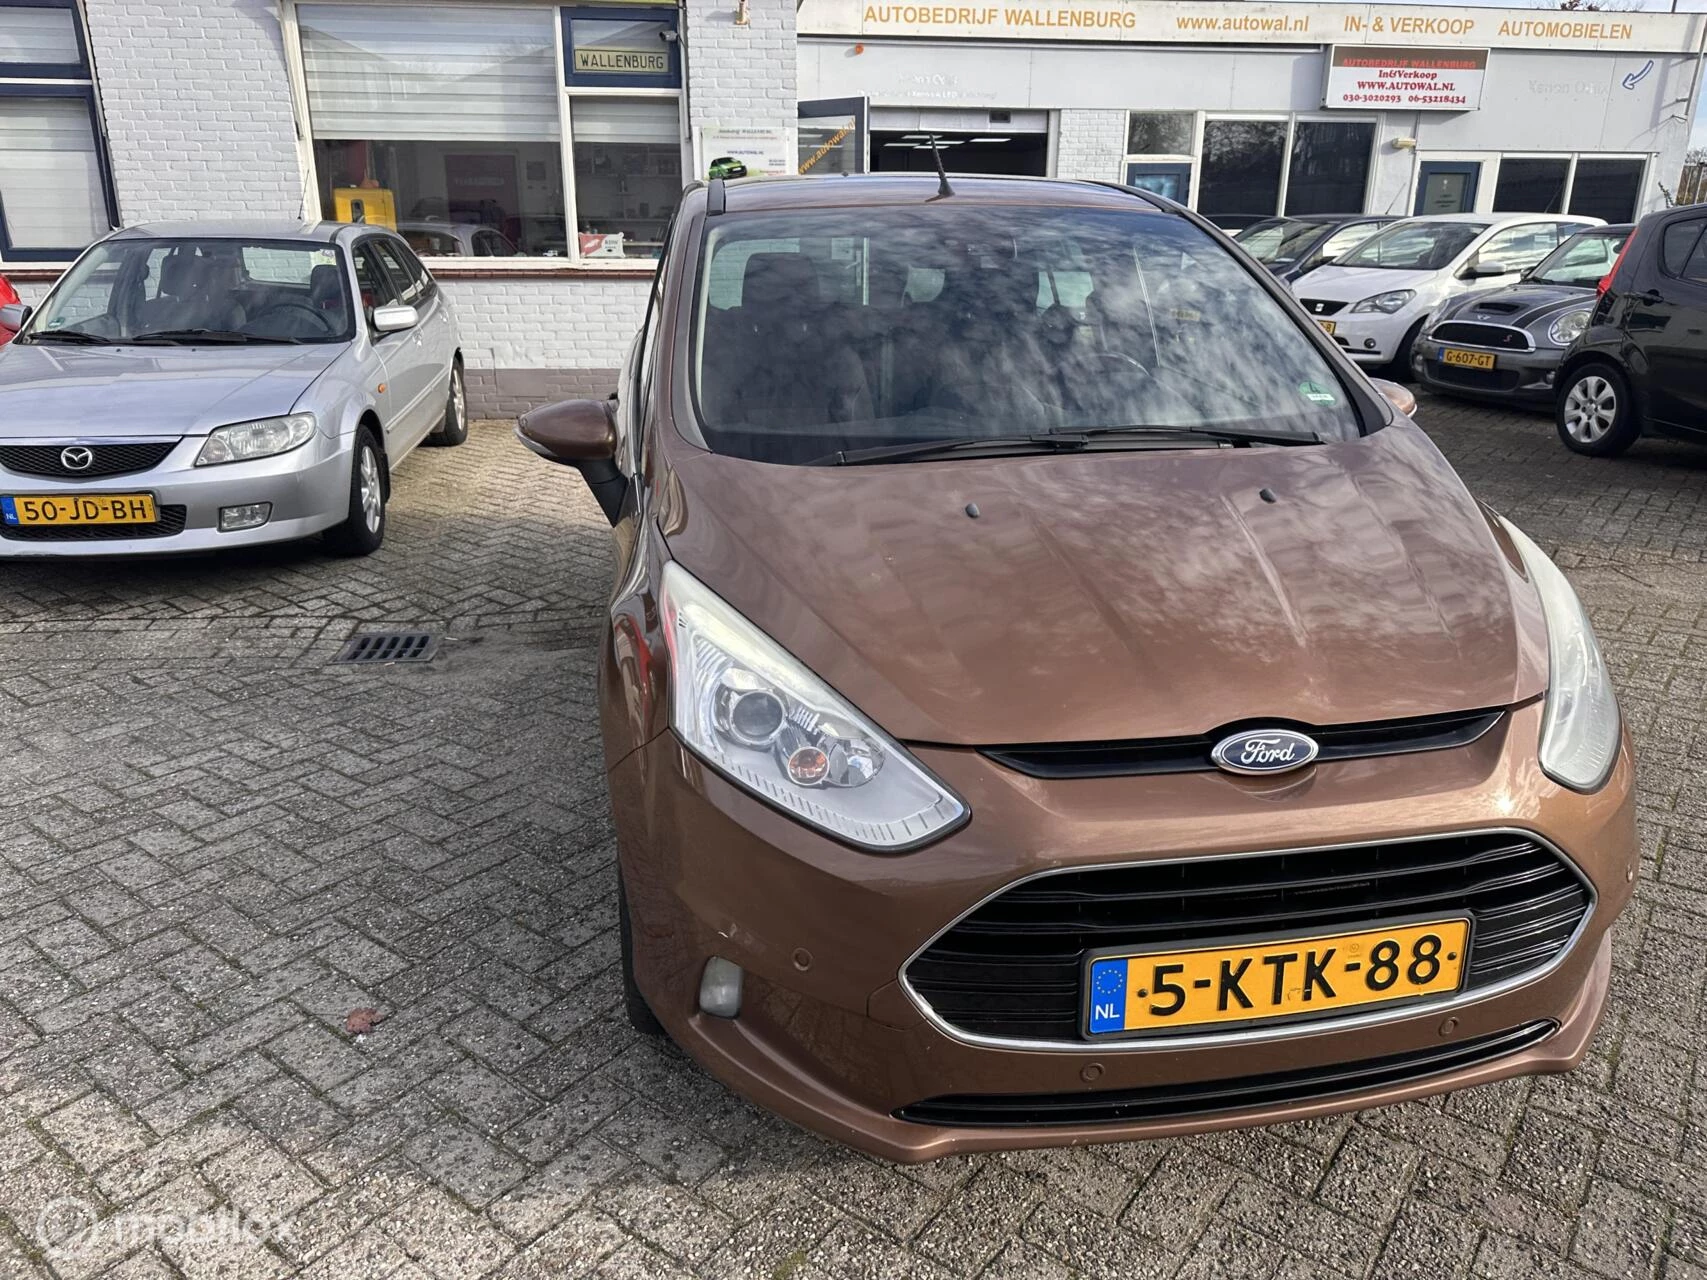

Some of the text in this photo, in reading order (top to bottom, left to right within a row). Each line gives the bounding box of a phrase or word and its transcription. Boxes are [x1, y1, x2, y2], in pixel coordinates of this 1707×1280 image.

[863, 7, 1136, 29] AUTOBEDRIJF WALLENBURG
[1176, 15, 1309, 32] www.autowal.nl
[1344, 15, 1475, 35] IN- & VERKOOP
[1498, 20, 1632, 40] AUTOMOBIELEN
[580, 54, 664, 69] WALLENBURG
[1357, 81, 1456, 91] WWW.AUTOWAL.NL
[1446, 350, 1492, 367] G-607-GT
[23, 498, 147, 521] 50-JD-BH
[1240, 738, 1295, 764] Ford
[1095, 934, 1443, 1020] NL 5-KTK-88
